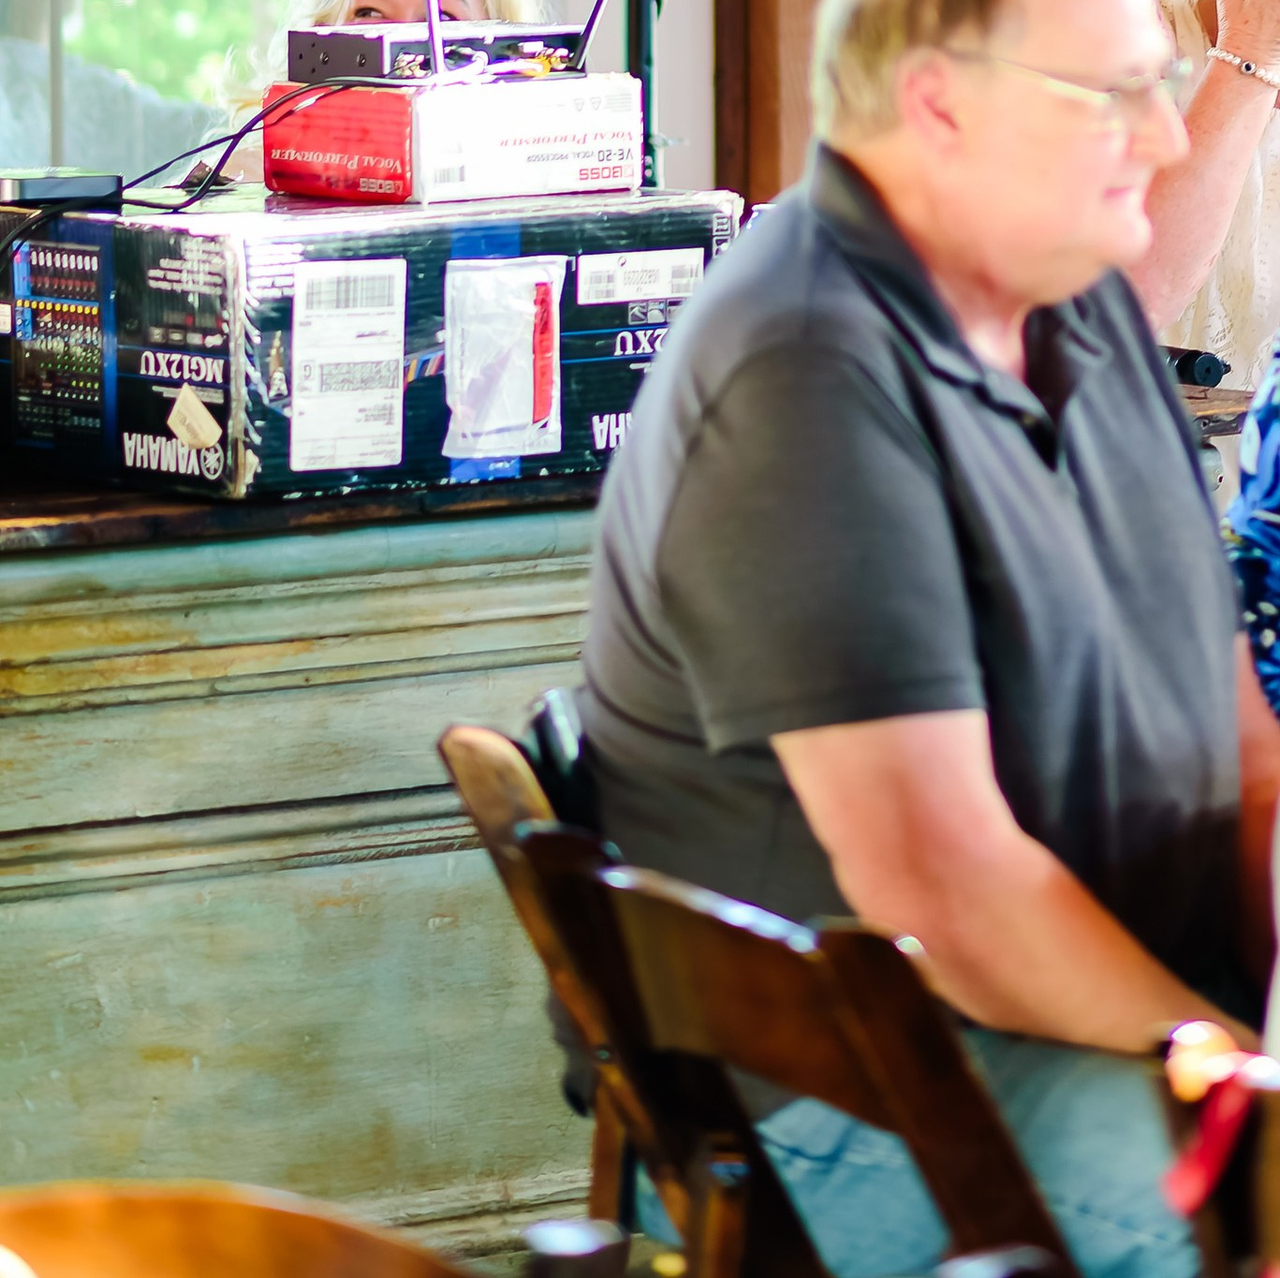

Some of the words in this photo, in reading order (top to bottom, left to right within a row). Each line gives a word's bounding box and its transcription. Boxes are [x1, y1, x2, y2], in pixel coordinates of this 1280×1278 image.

[592, 130, 633, 143] VOCAL
[270, 149, 360, 170] PERFORMER
[362, 155, 402, 174] VOCAL
[597, 148, 634, 162] VE-20
[578, 165, 624, 182] BOSS
[613, 327, 669, 356] 2XU
[139, 351, 225, 384] MG12XU
[123, 432, 201, 477] YAMAHA
